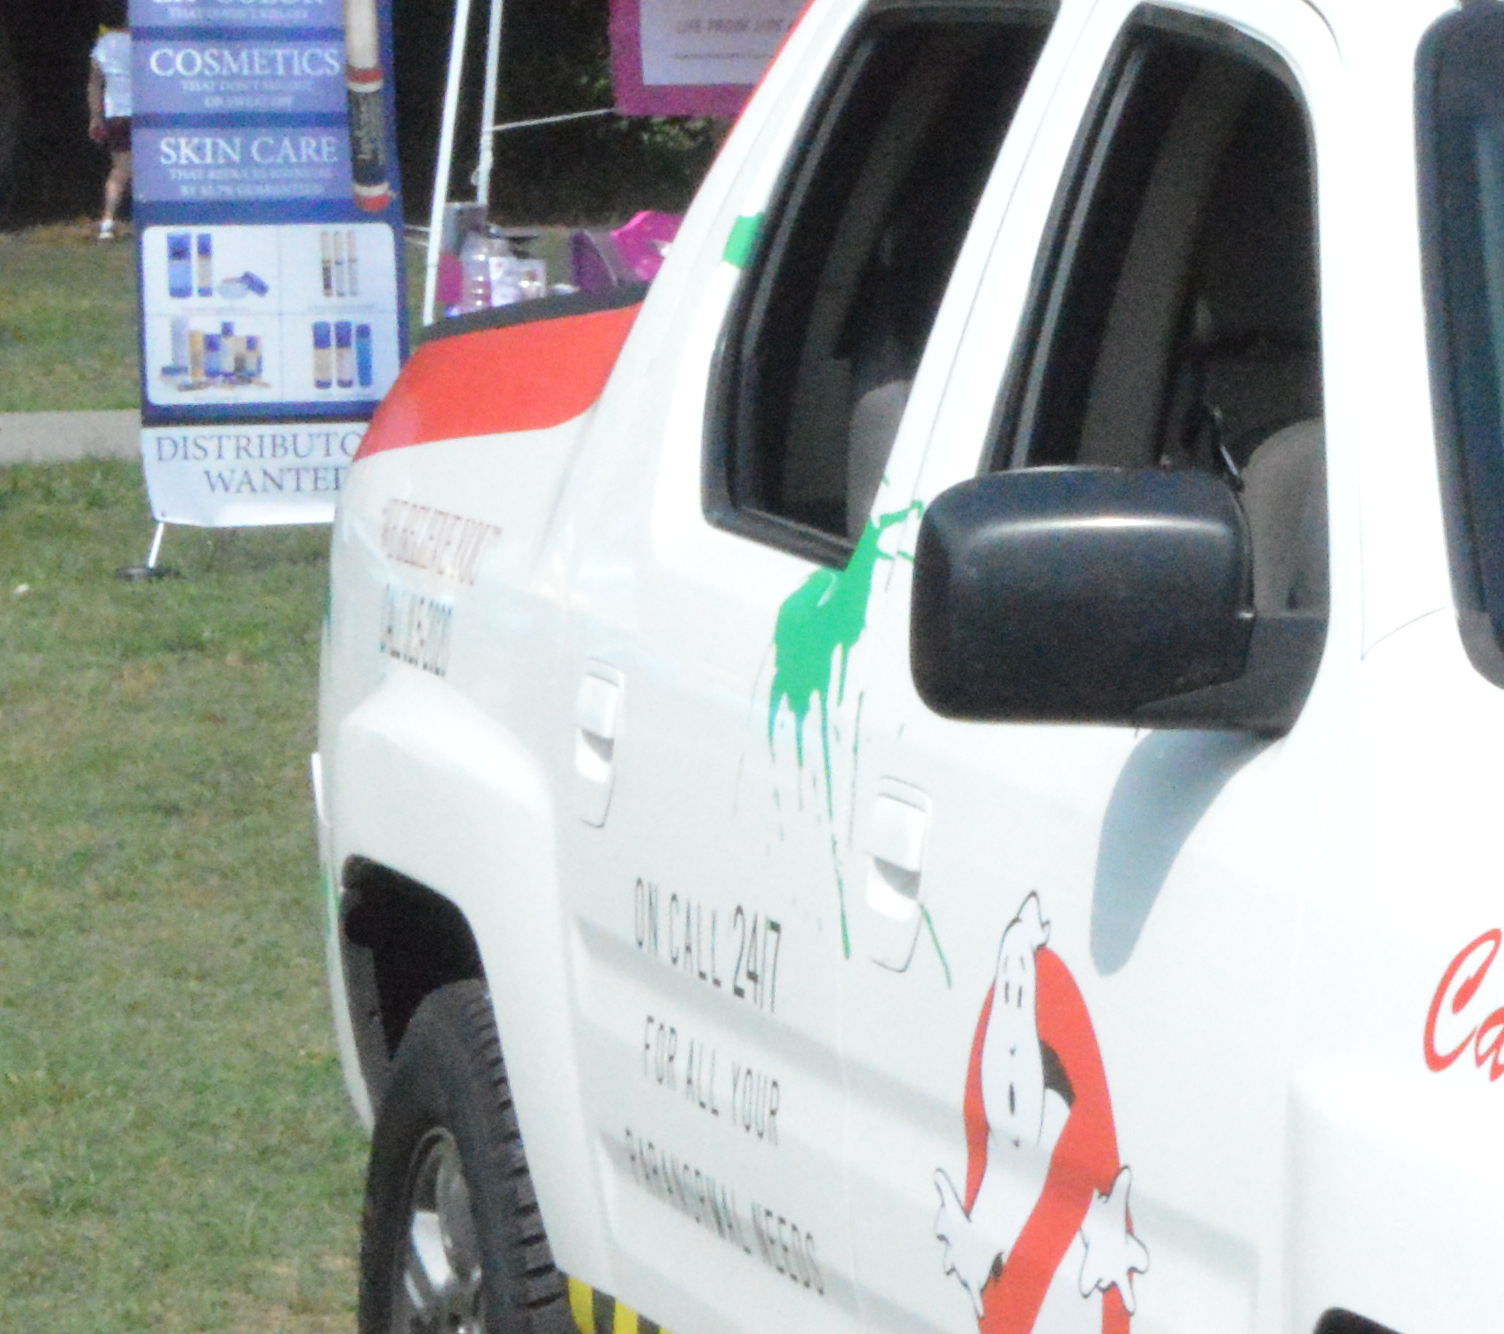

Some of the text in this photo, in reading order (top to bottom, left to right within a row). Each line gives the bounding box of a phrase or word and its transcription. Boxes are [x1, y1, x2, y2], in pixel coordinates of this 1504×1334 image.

[149, 47, 341, 77] COSMETICS
[159, 135, 339, 165] SKIN CARE
[633, 876, 660, 958] ON
[668, 892, 722, 989] CALL
[643, 1014, 781, 1148] FOR ALL YOUR
